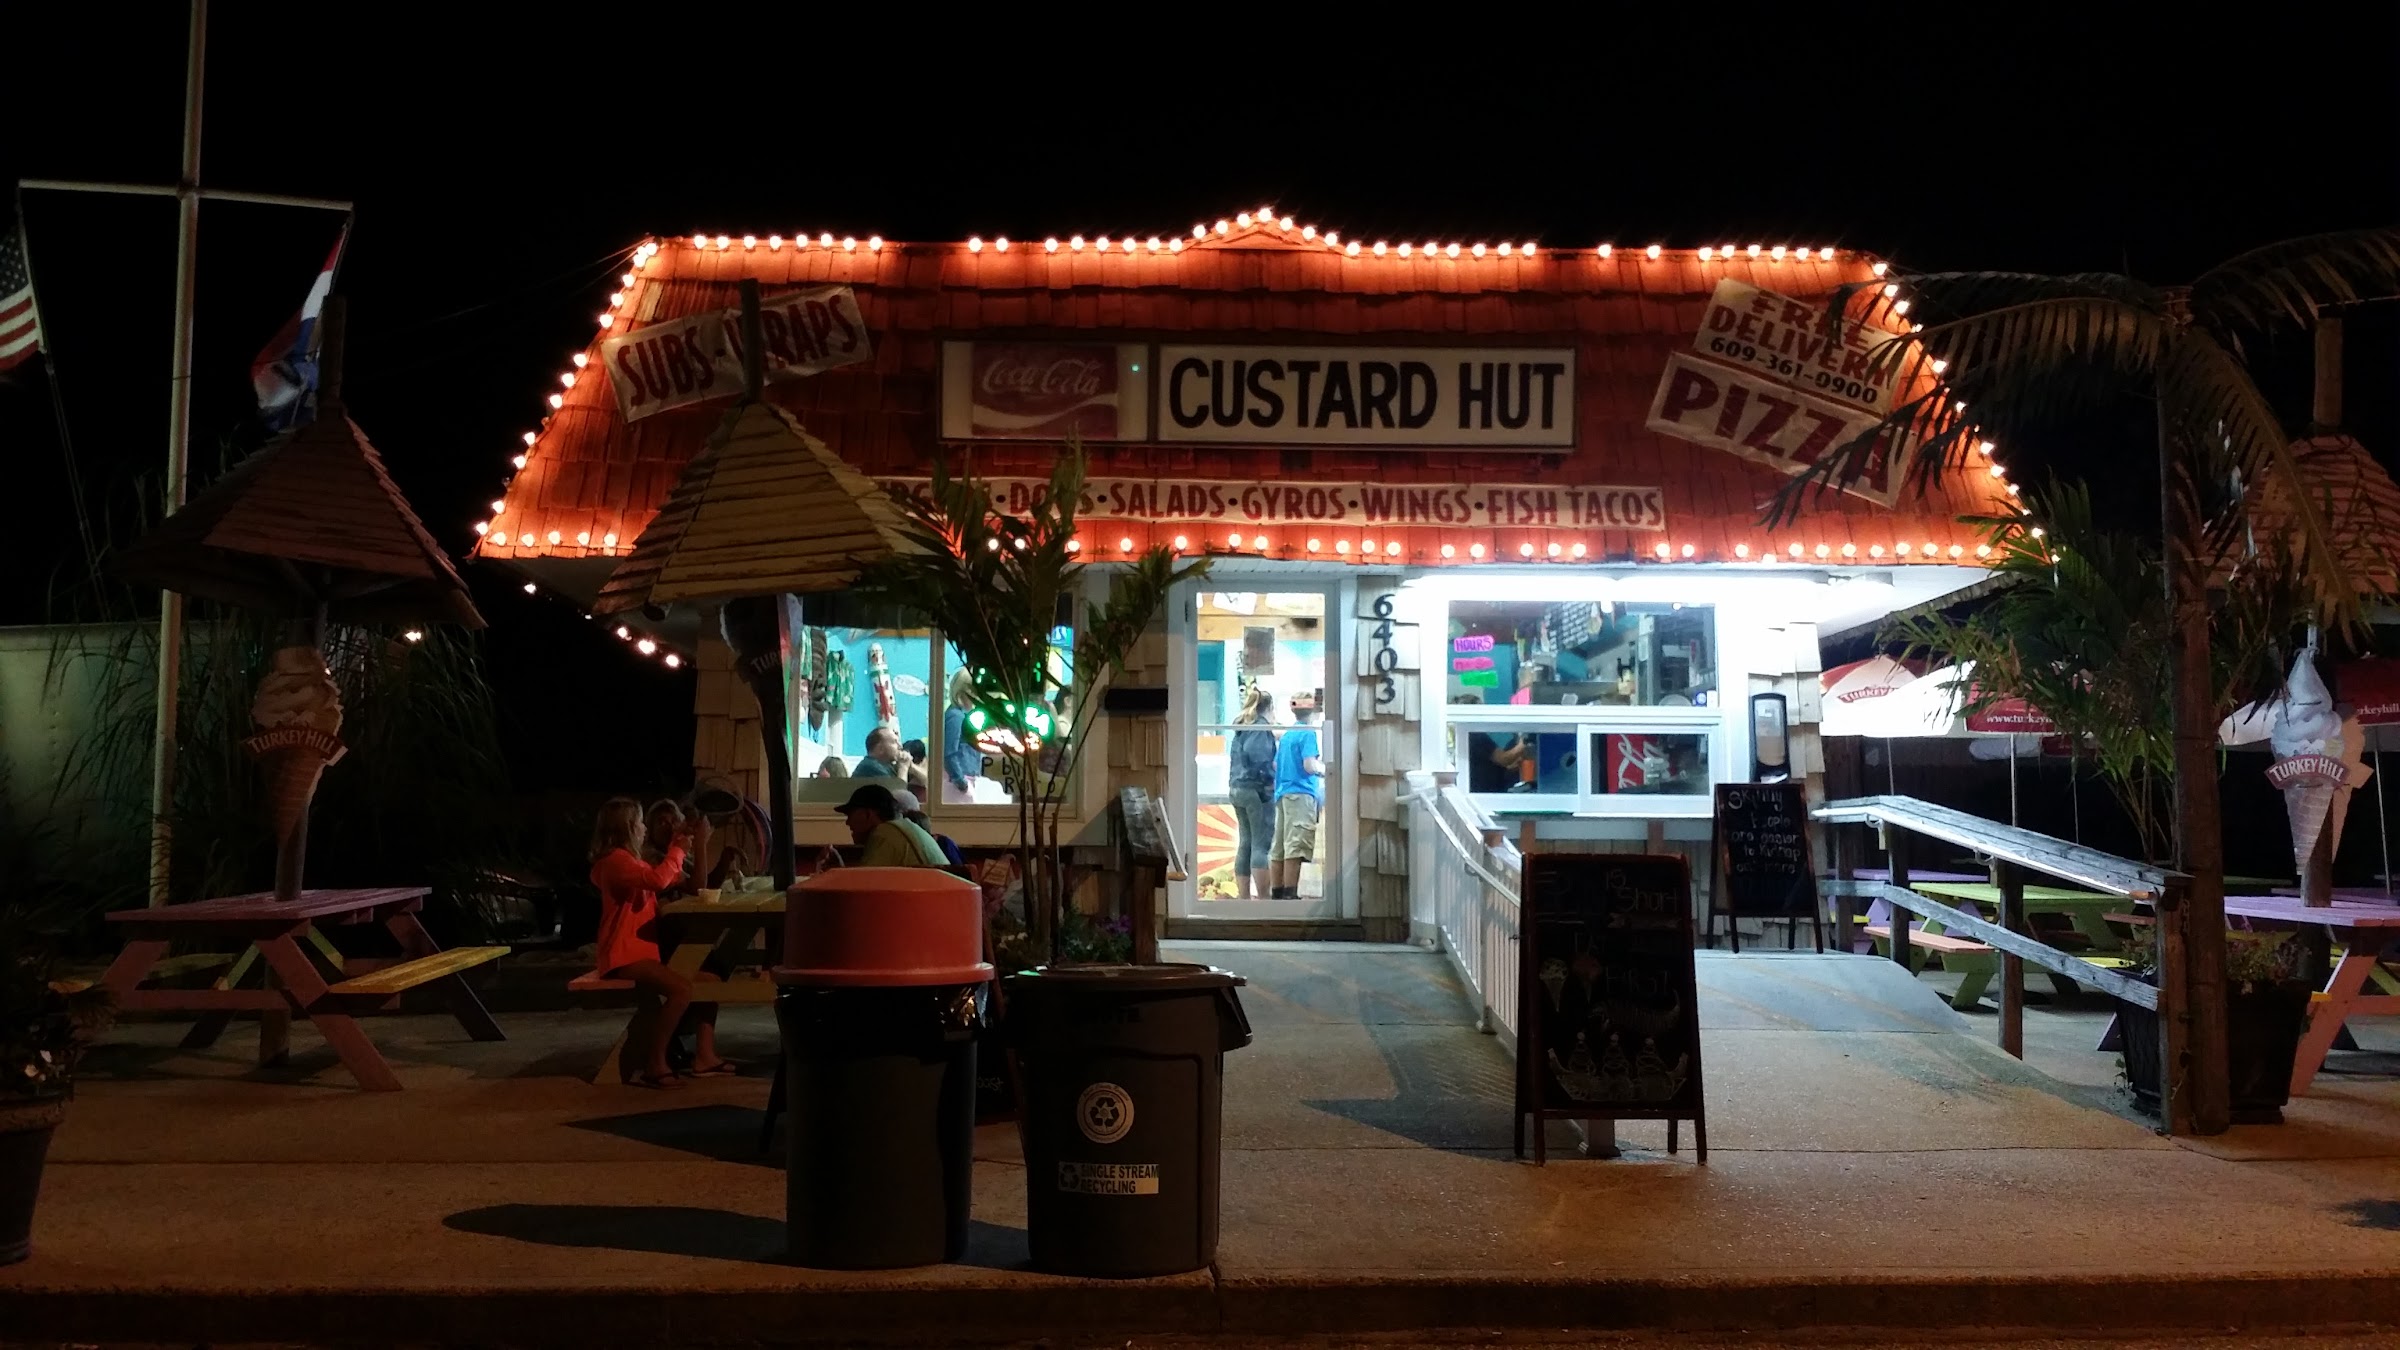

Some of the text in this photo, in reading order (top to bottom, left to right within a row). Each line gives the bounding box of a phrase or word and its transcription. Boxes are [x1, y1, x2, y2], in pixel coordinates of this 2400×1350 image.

[616, 324, 716, 408] SUBS
[1710, 336, 1879, 405] 609-361-0900
[1169, 357, 1565, 430] CUSTARD HUT
[1660, 366, 1889, 494] PIZZA
[1009, 481, 1095, 516] DOS
[1109, 482, 1226, 519] SALADS
[1241, 486, 1346, 521] GYROS
[1360, 487, 1472, 524] WINGS
[1487, 489, 1558, 525] FISH
[1566, 490, 1662, 526] TACOS
[246, 729, 335, 755] TURKEY HILL
[2269, 757, 2345, 782] TURKEY HILL
[1080, 1178, 1137, 1194] RECYCLING
[1081, 1163, 1159, 1179] SINGLE STREAM
